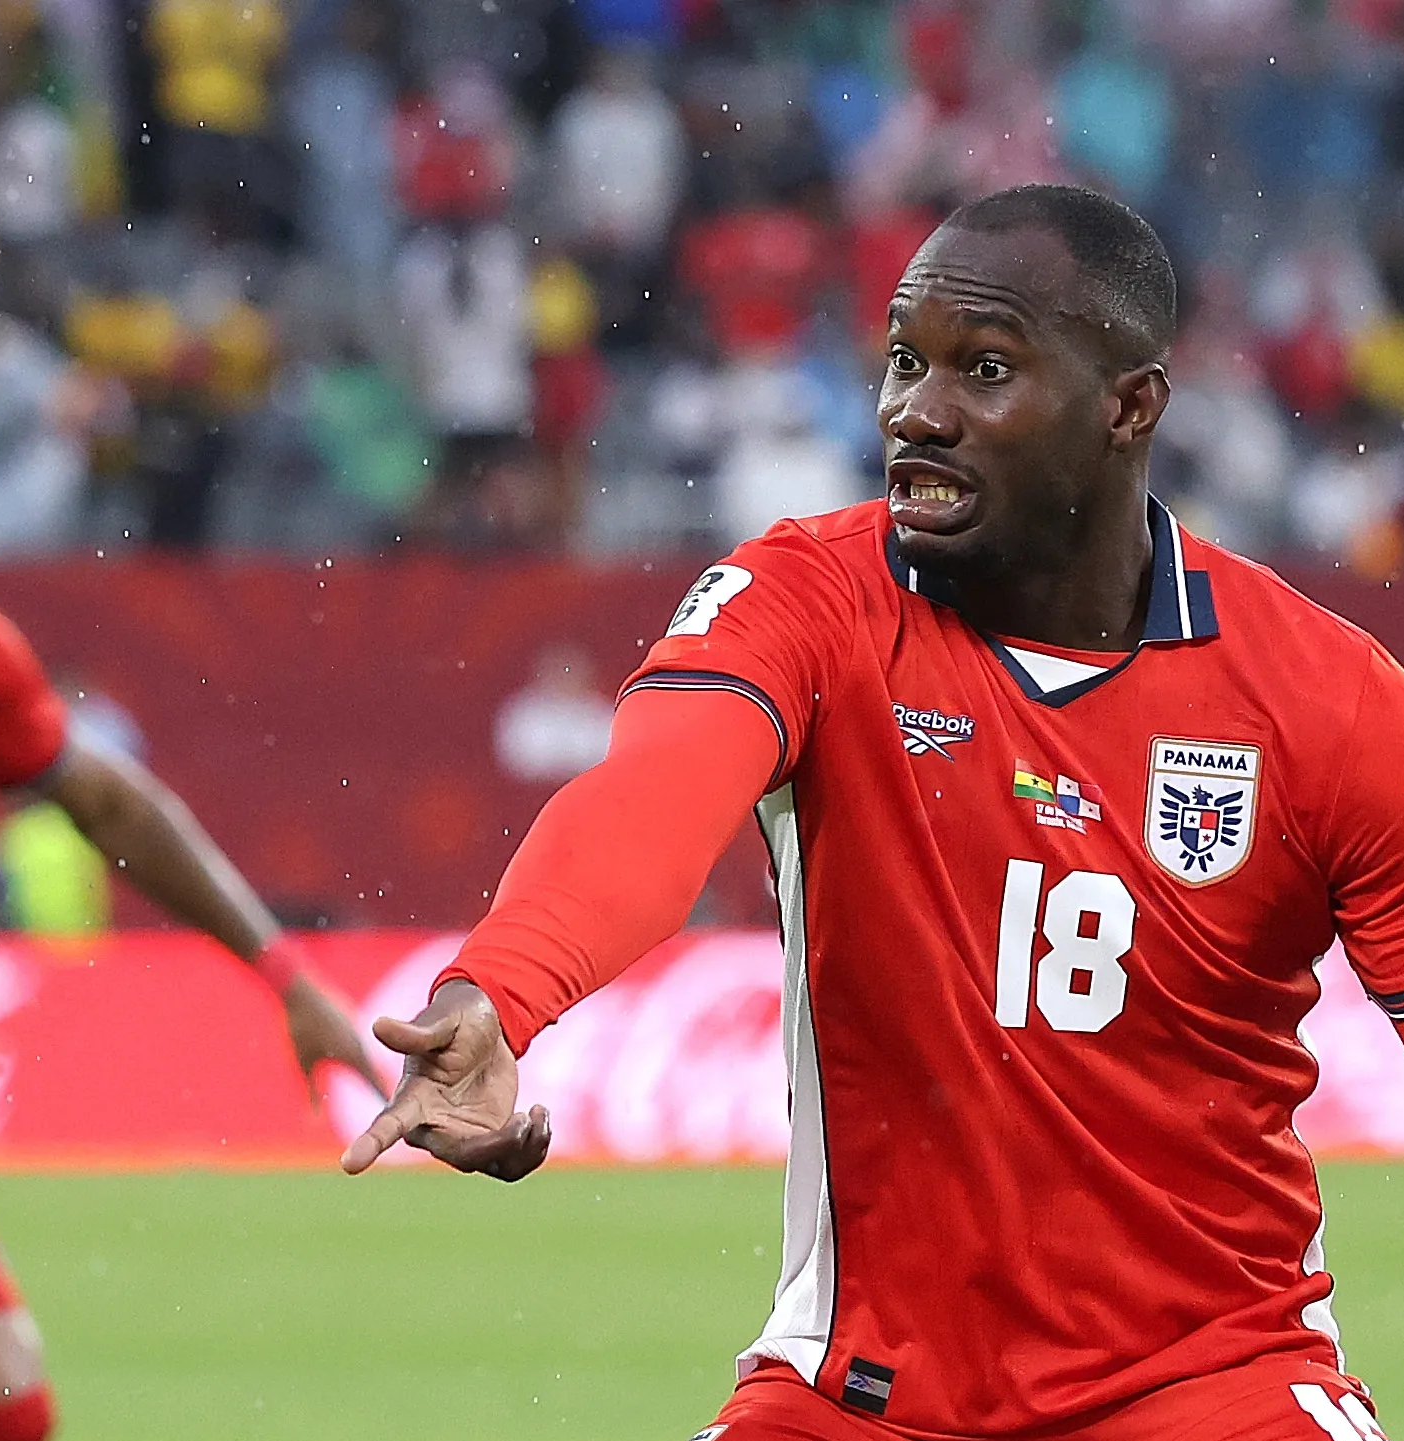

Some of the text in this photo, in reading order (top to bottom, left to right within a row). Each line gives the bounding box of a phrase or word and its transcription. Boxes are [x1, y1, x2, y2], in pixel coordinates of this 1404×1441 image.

[892, 704, 975, 735] Reebok
[1163, 750, 1248, 771] PANAMÁ
[995, 858, 1137, 1033] 18
